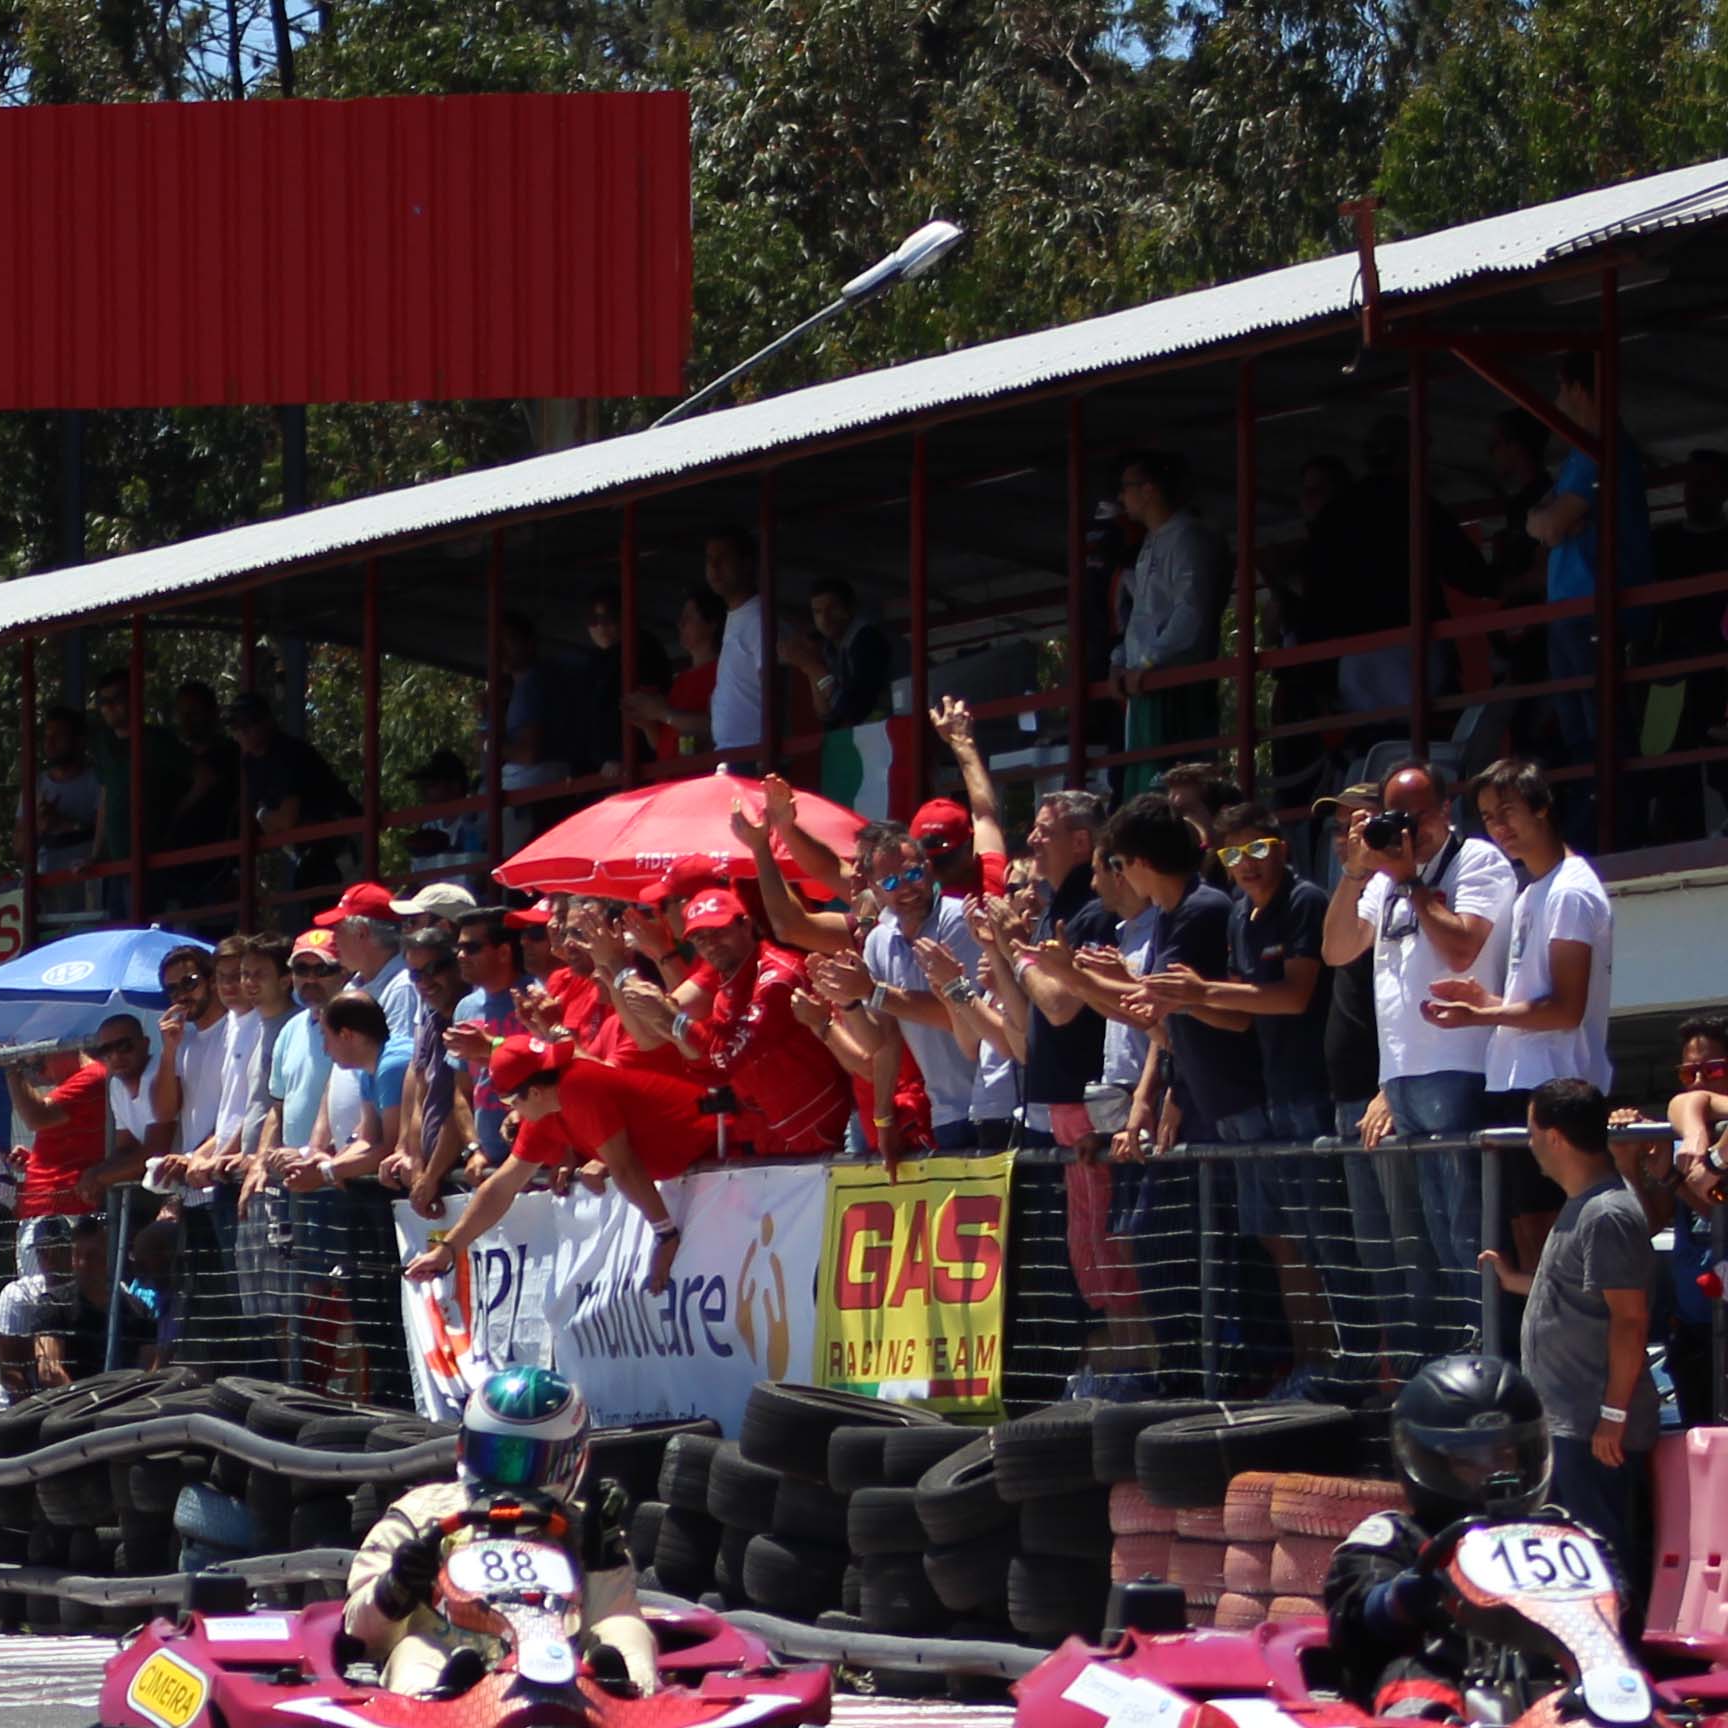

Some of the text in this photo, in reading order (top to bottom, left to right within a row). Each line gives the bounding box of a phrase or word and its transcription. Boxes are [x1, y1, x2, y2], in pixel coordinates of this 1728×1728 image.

[833, 1195, 1002, 1311] GAS
[829, 1335, 996, 1377] RACING TEAM
[481, 1550, 538, 1581] 88
[1491, 1537, 1592, 1589] 150
[138, 1664, 194, 1718] CIMEIRA
